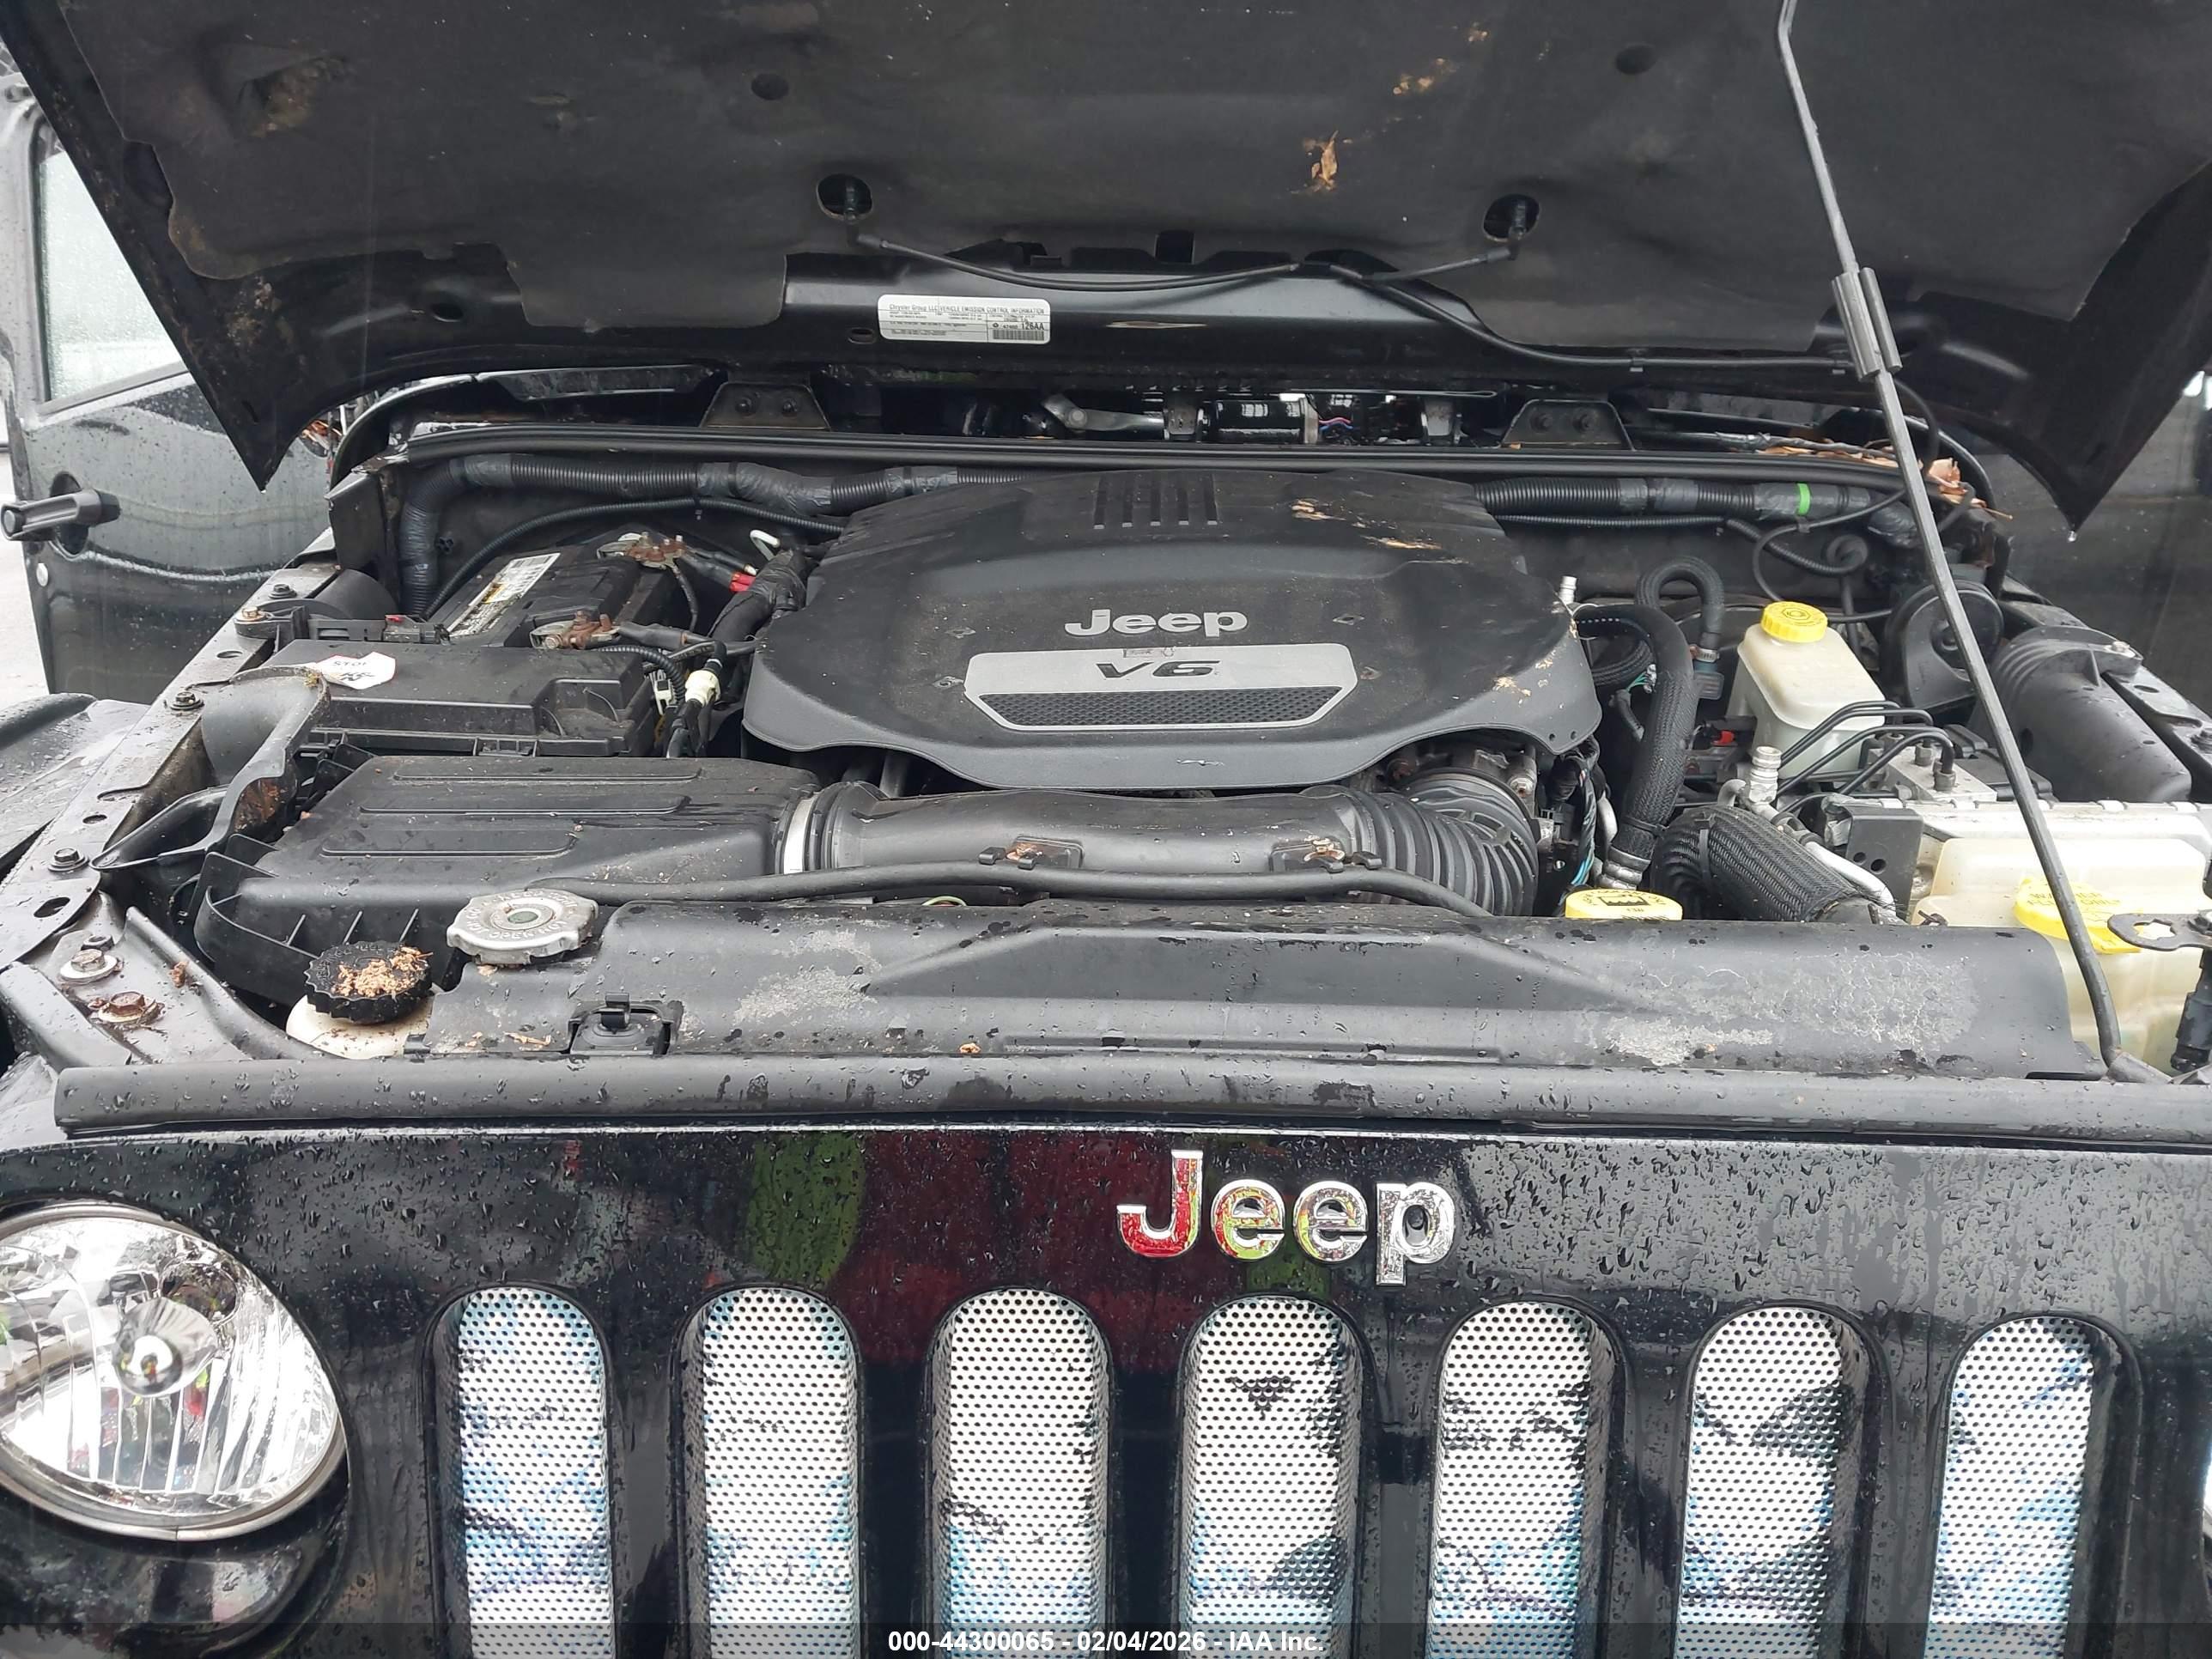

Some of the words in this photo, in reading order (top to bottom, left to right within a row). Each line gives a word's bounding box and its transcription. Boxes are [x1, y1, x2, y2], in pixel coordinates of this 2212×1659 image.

[1065, 609, 1248, 638] Jeep
[1096, 660, 1220, 680] V6
[1117, 1150, 1455, 1285] Jeep
